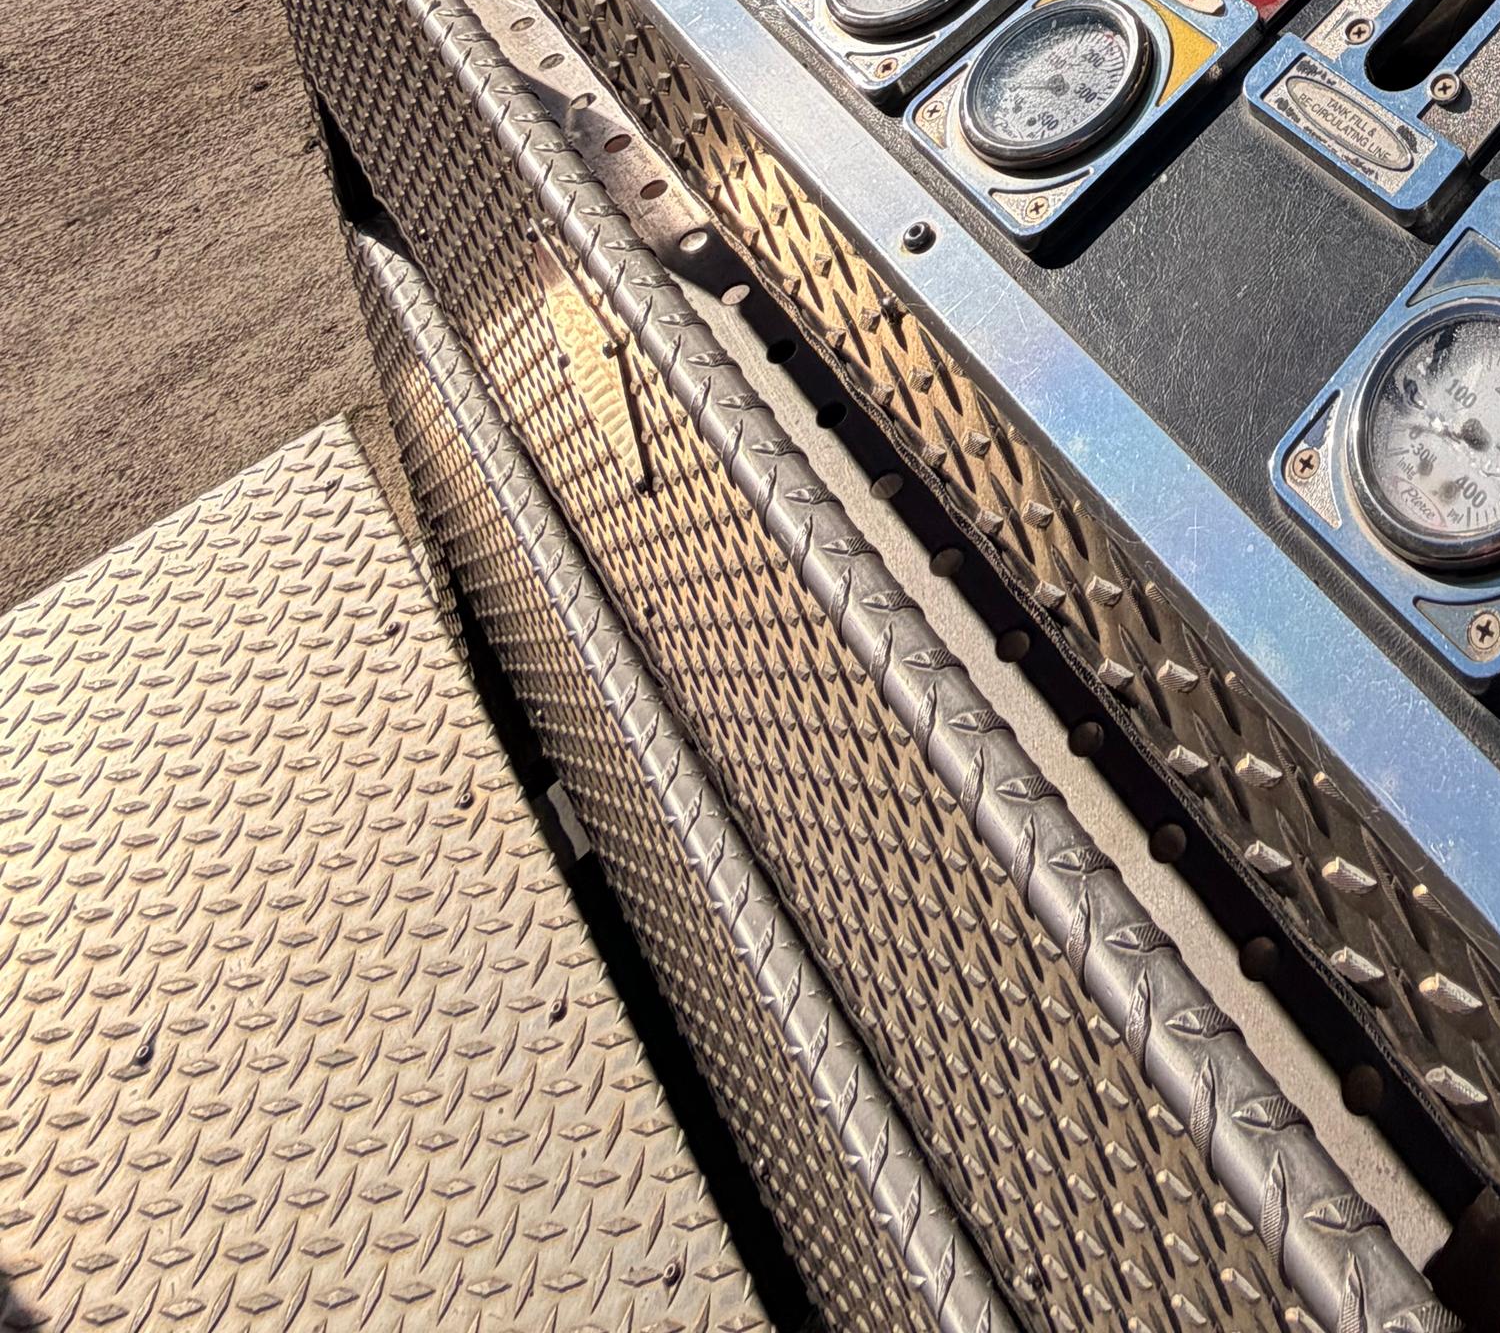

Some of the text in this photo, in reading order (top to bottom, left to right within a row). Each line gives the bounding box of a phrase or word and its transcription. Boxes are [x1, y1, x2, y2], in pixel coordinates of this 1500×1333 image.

[1082, 49, 1107, 69] 200
[1073, 83, 1099, 104] 300
[1299, 93, 1392, 163] RE-CIRCULATING LINE
[1325, 97, 1378, 138] TANK FILL &
[1445, 378, 1478, 409] 100
[1400, 485, 1437, 520] Pierce
[1456, 475, 1488, 509] 400
